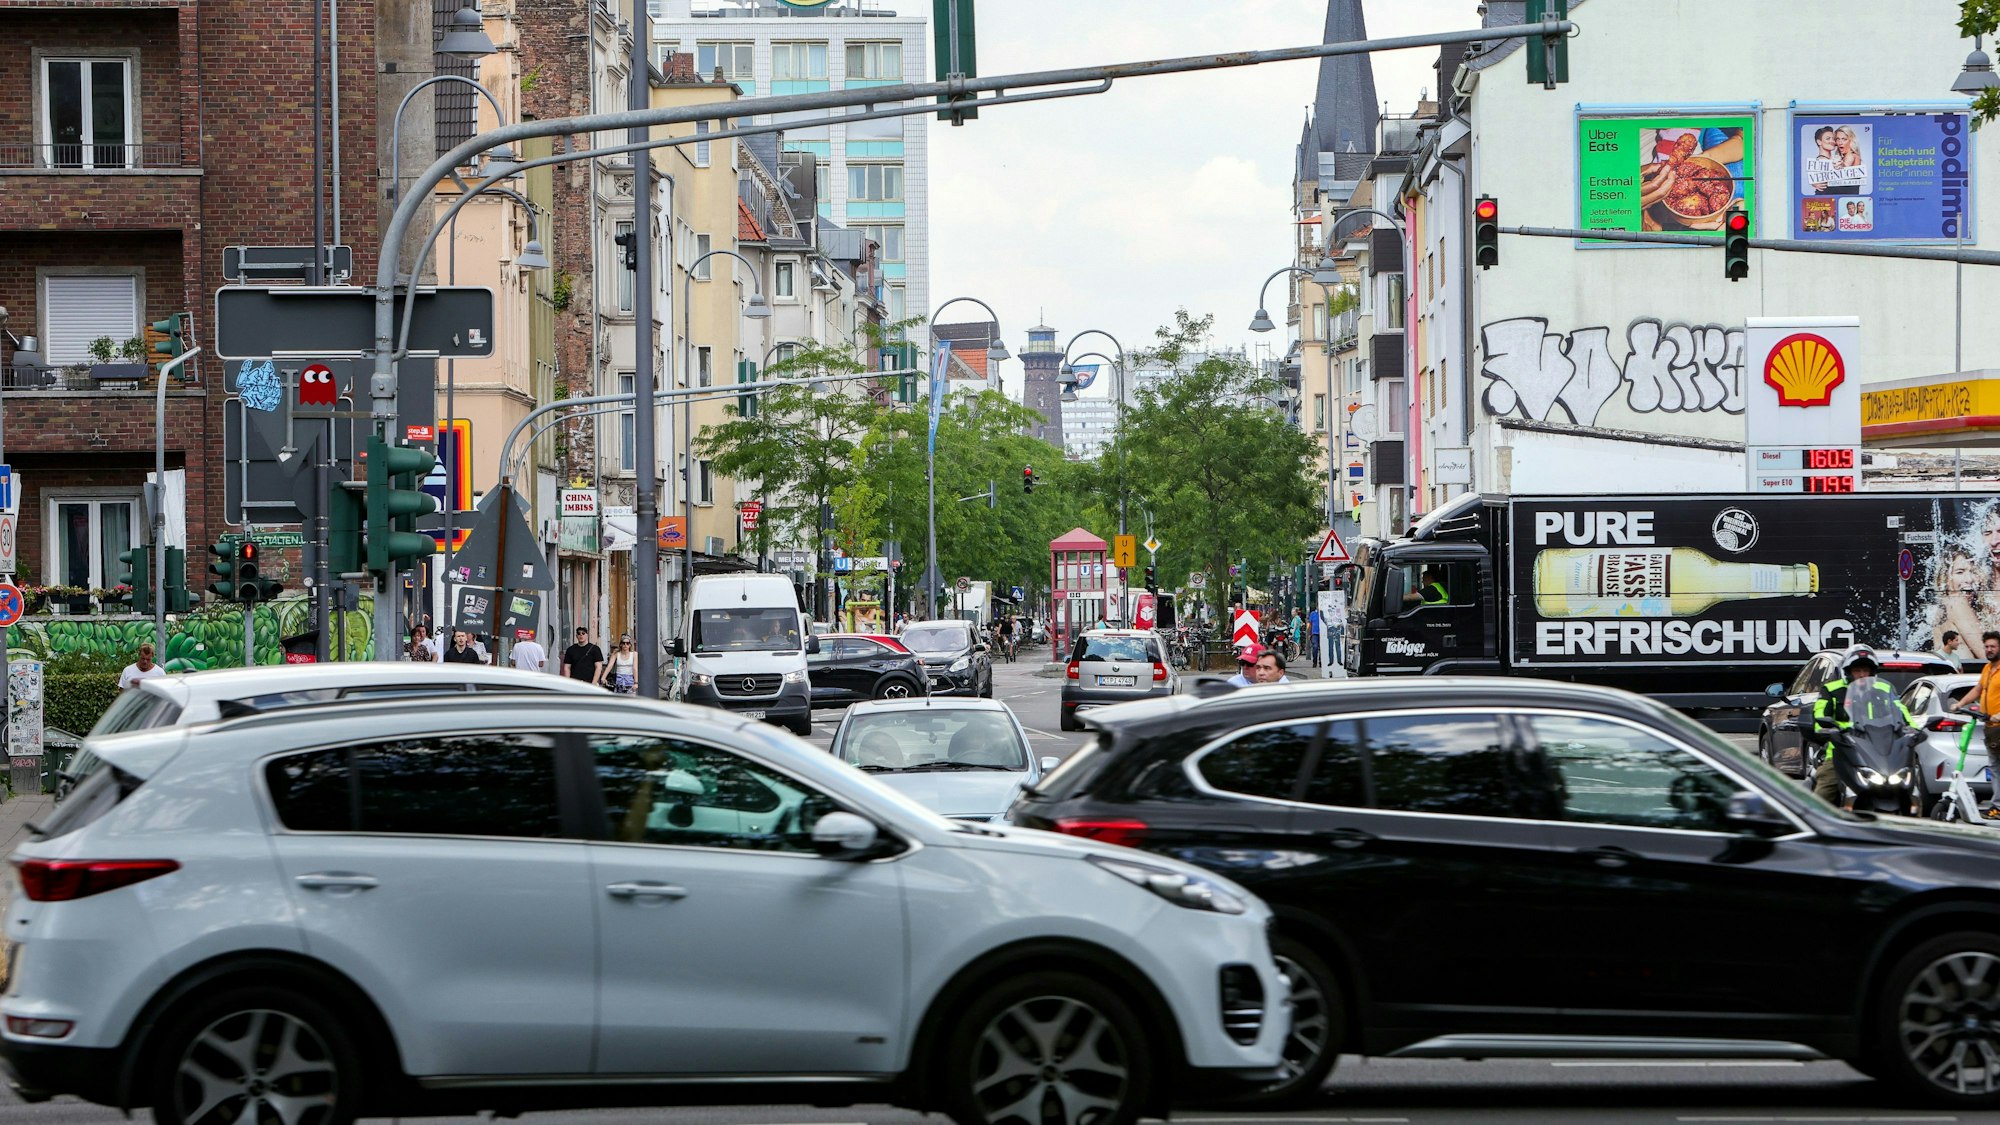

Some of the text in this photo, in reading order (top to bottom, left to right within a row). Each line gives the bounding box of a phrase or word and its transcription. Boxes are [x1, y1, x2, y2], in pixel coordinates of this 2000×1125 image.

[1588, 129, 1618, 140] Uber
[1878, 136, 1893, 145] Für
[1589, 141, 1619, 152] Eats
[1878, 146, 1936, 156] Klatsch und
[1878, 157, 1936, 168] Kaltgetränk
[1589, 176, 1633, 187] Erstmal
[1934, 115, 1968, 238] podimo
[1589, 189, 1627, 200] Essen.
[1589, 208, 1608, 216] Jetzt
[1809, 449, 1854, 468] 160.9
[1762, 479, 1780, 487] Super
[1782, 478, 1793, 486] E10
[1734, 512, 1745, 521] DAS
[1535, 511, 1656, 545] PURE
[3, 529, 10, 546] 30
[1, 559, 12, 570] ZONE
[837, 559, 846, 569] U
[1606, 554, 1621, 597] BRAUSE
[1623, 554, 1647, 598] FASS
[1649, 553, 1663, 598] GAFFELS
[1535, 618, 1855, 655] ERFRISCHUNG
